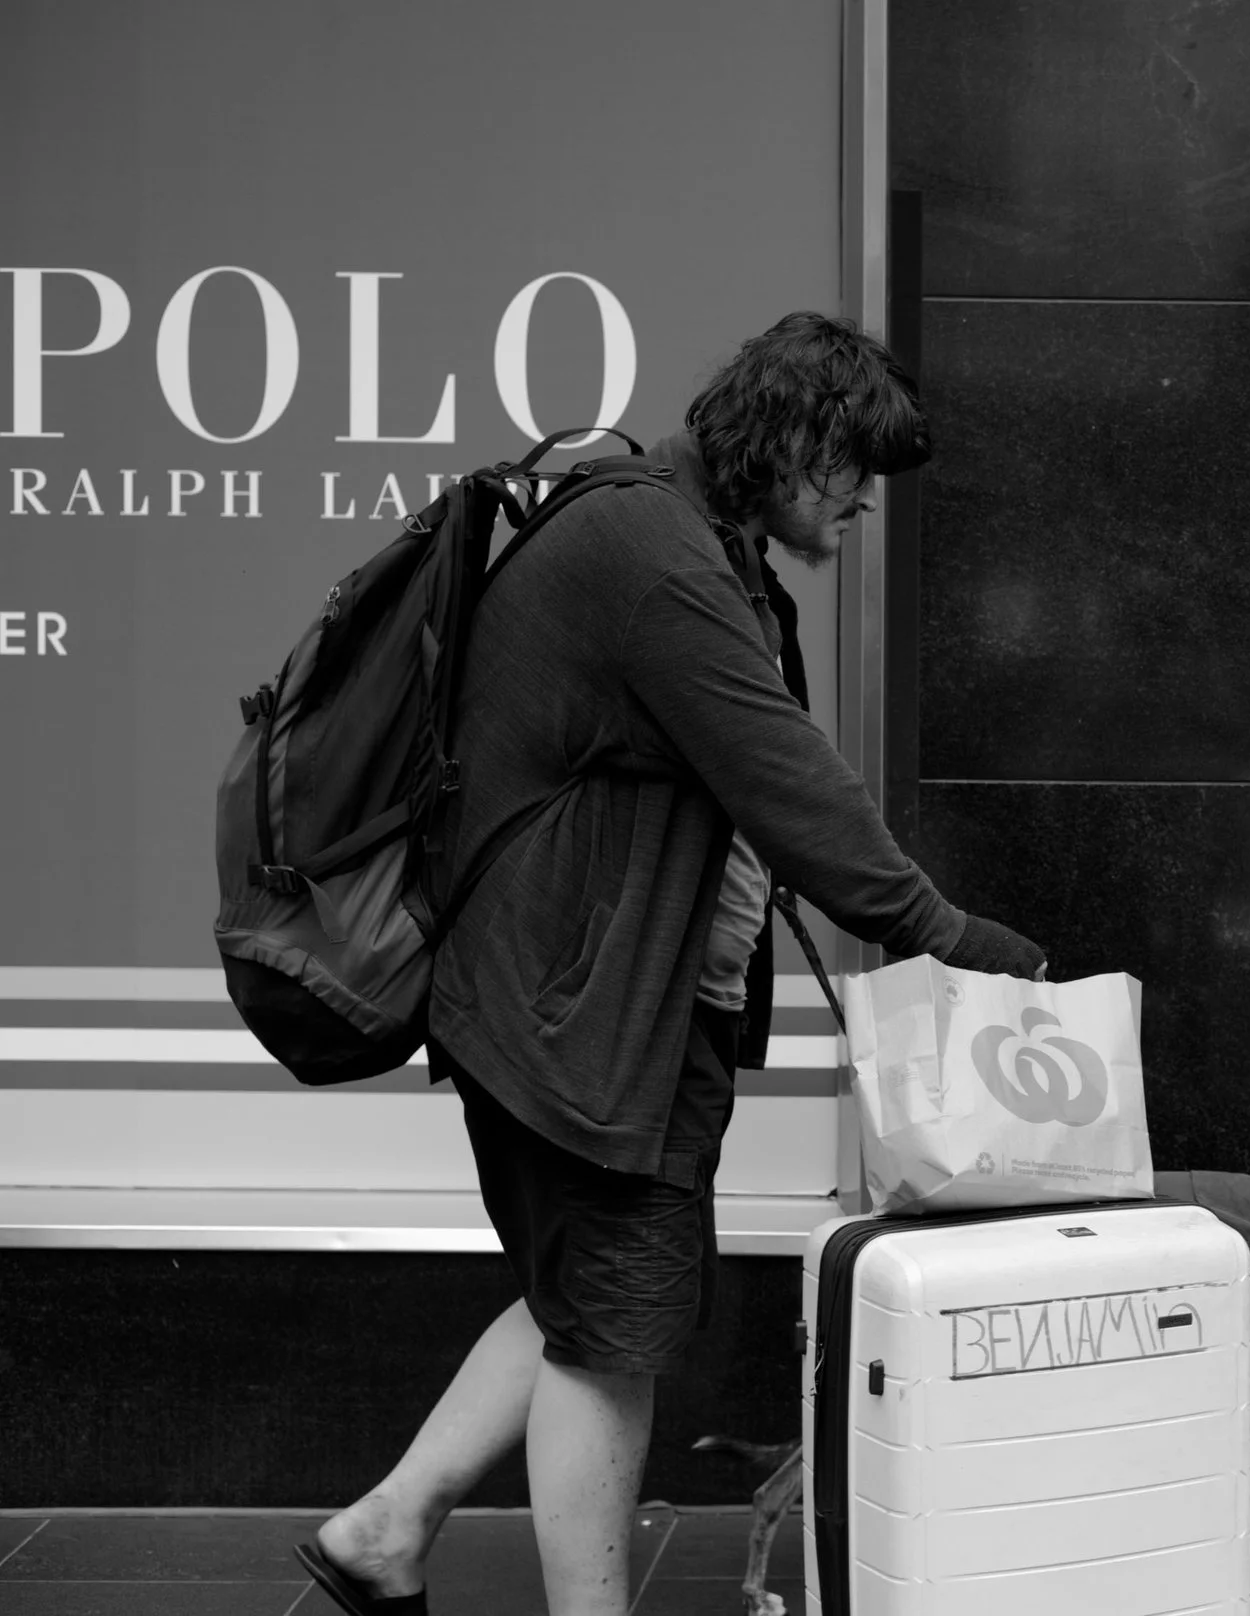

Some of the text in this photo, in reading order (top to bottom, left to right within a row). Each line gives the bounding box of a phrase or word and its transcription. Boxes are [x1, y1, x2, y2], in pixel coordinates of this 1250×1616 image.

[0, 266, 637, 449] POLO
[10, 468, 263, 518] RALPH
[0, 611, 68, 656] ER
